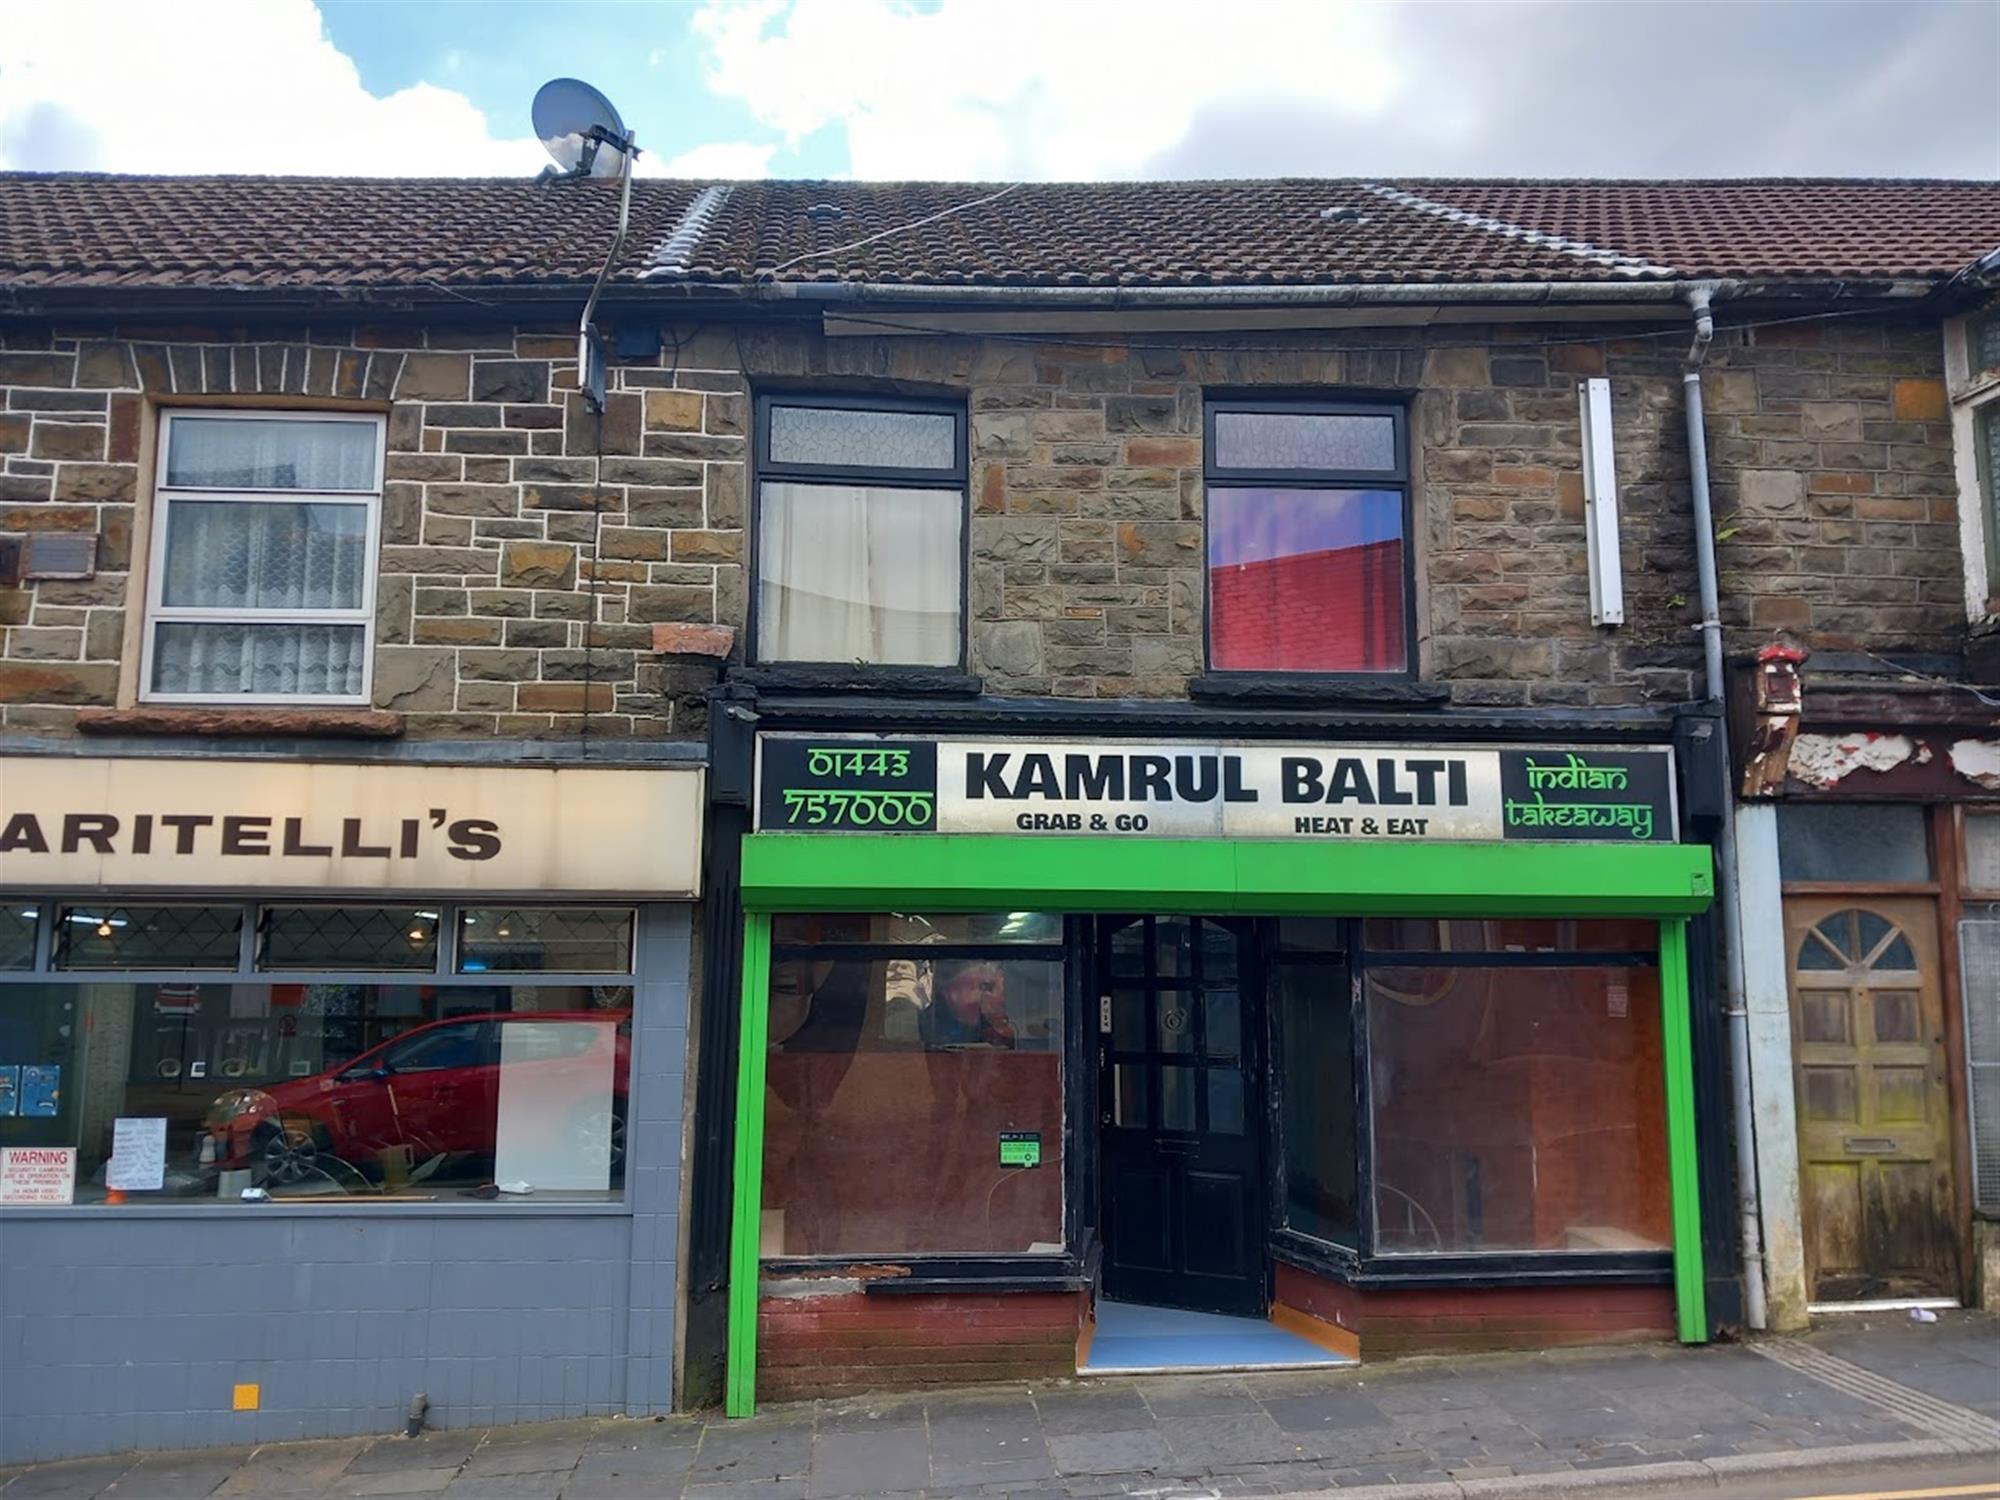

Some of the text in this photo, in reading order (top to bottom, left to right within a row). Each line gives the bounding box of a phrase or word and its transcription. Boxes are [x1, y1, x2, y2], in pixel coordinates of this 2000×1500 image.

[807, 748, 911, 778] 01443
[965, 752, 1469, 806] KAMRUL BALTI
[1526, 754, 1628, 792] indian
[783, 788, 935, 826] 757000
[1016, 812, 1149, 832] GRAB & GO
[1505, 792, 1654, 839] takeaway
[1294, 816, 1429, 836] HEAT & EAT
[9, 1151, 68, 1165] WARNING
